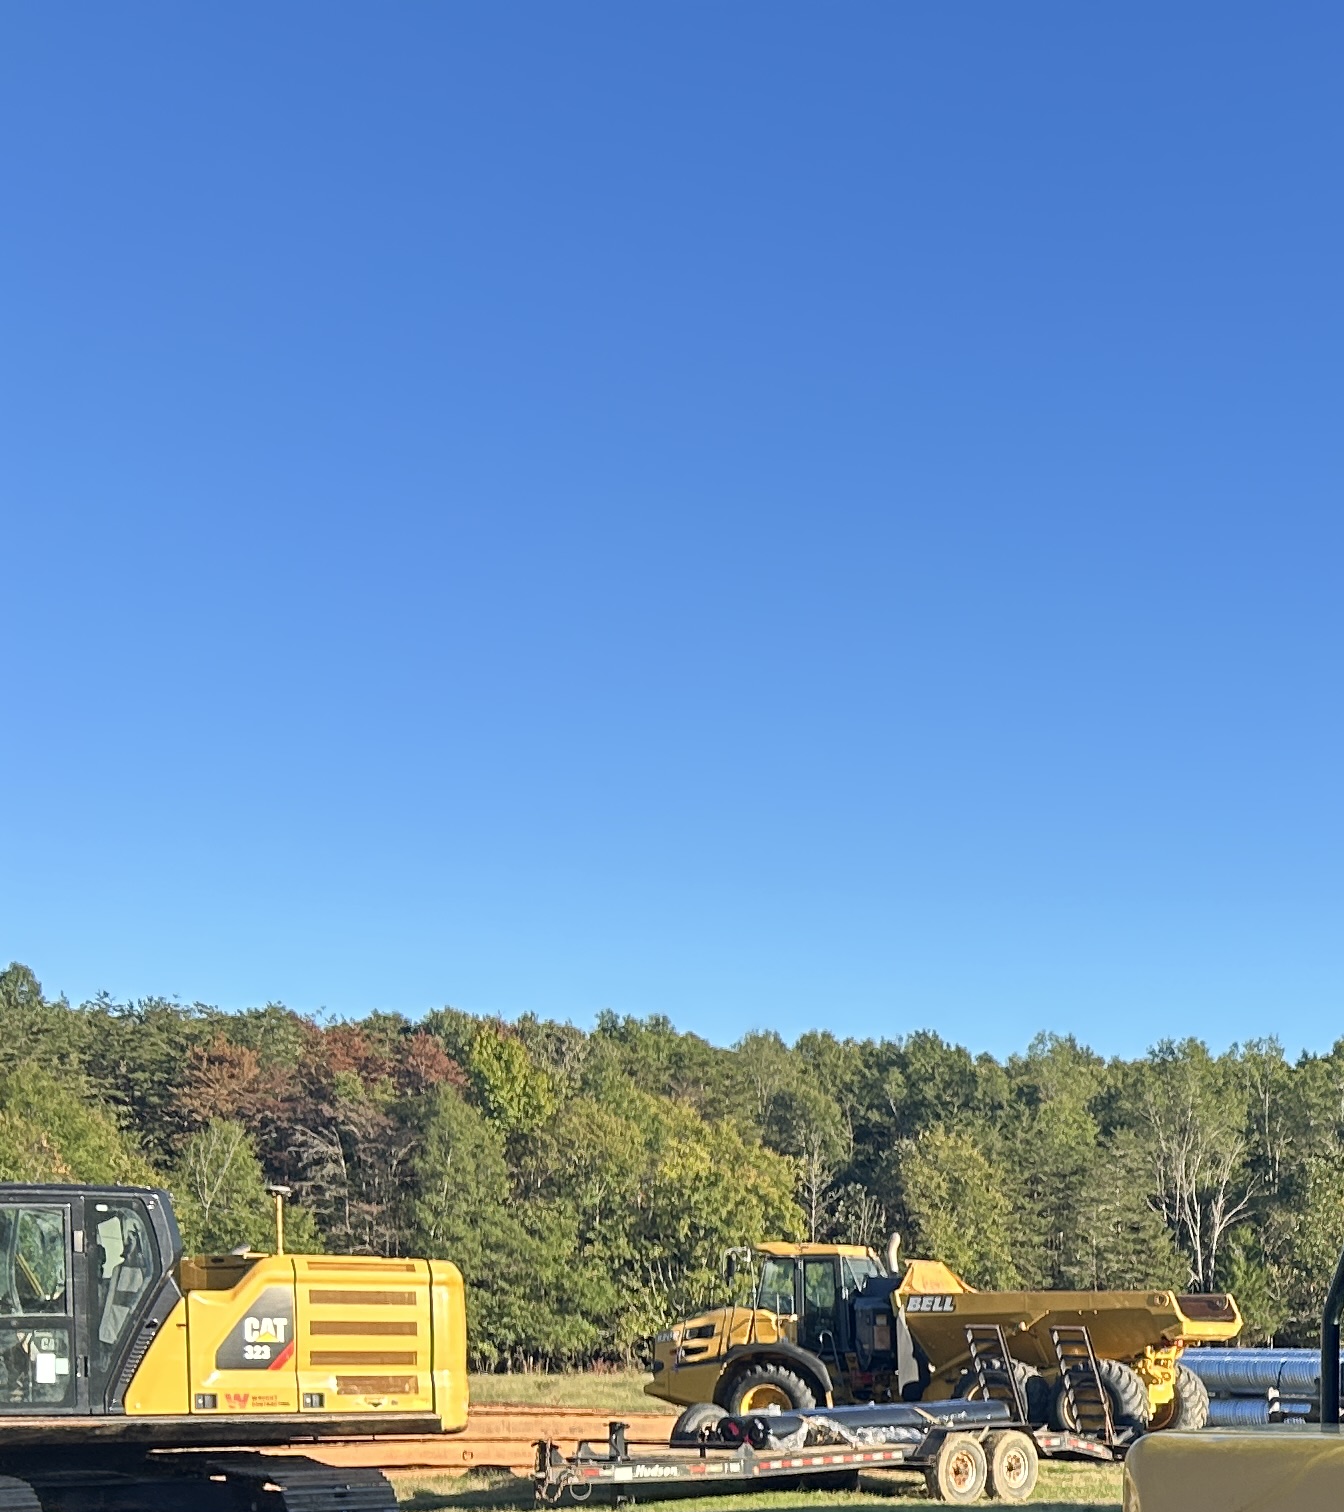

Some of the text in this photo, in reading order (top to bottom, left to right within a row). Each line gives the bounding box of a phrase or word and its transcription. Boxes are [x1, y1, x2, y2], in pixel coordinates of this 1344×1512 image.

[906, 1295, 954, 1312] BELL
[244, 1316, 288, 1343] CAT
[243, 1344, 271, 1360] 323
